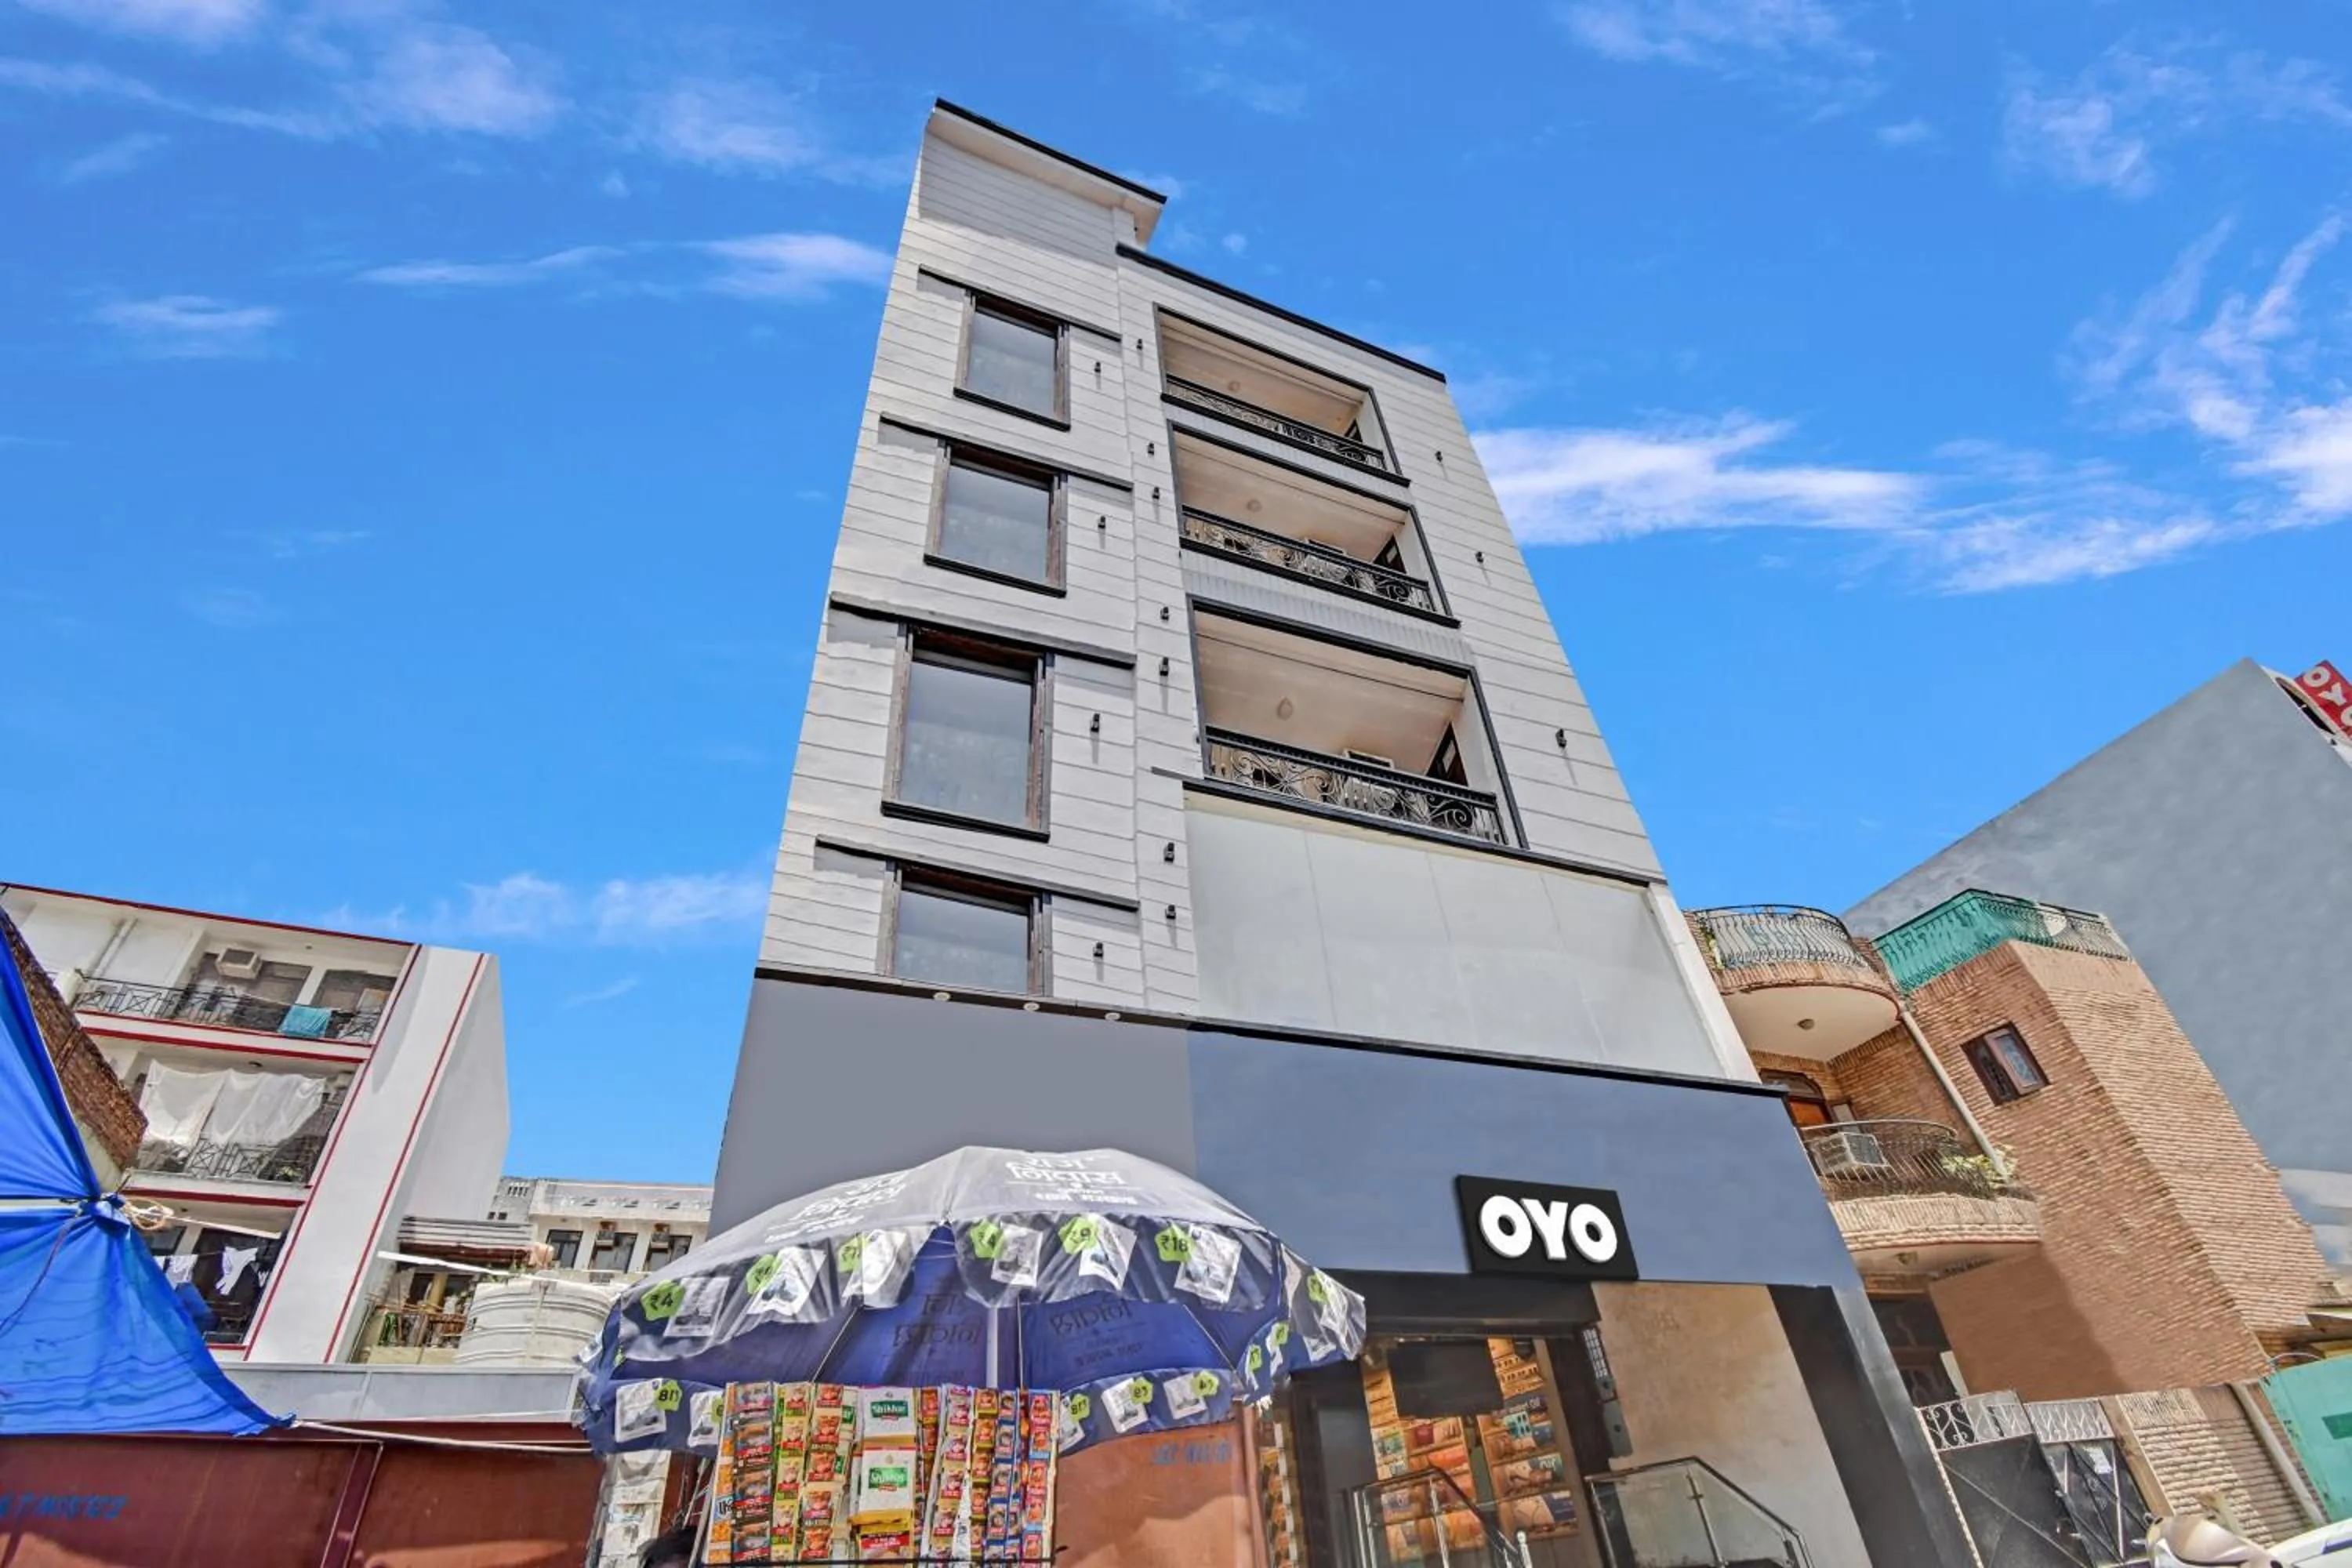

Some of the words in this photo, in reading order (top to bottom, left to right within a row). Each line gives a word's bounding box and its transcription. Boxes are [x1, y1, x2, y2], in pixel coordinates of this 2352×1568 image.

[1479, 1195, 1617, 1263] OYO
[1161, 1236, 1189, 1253] ₹18
[650, 1291, 674, 1312] ₹4
